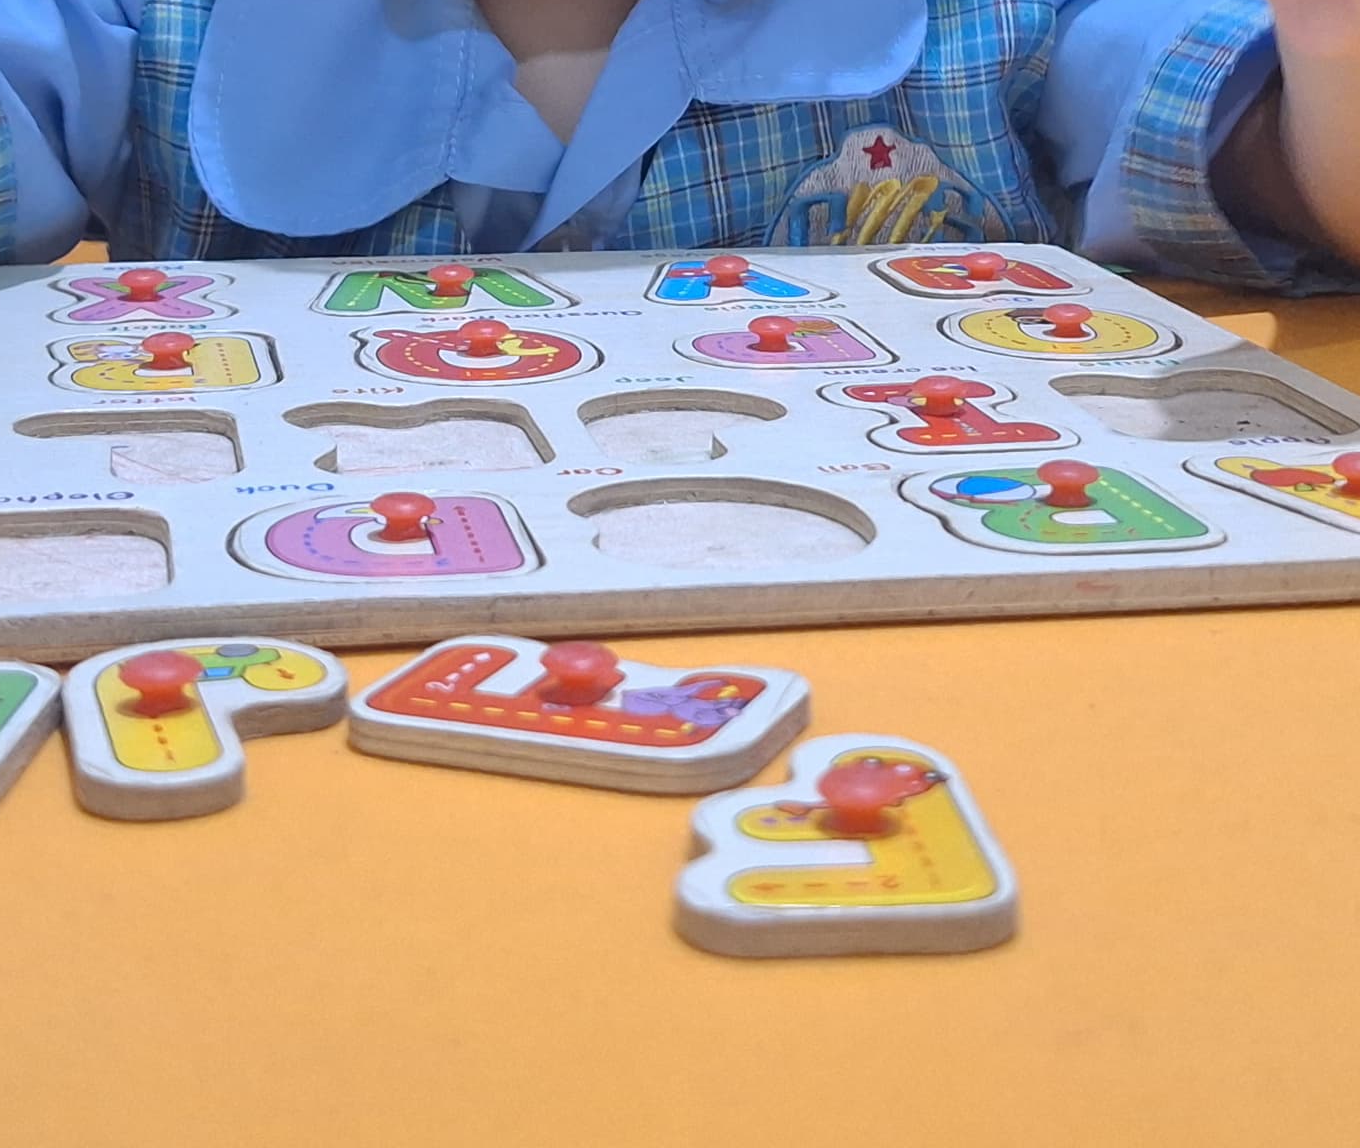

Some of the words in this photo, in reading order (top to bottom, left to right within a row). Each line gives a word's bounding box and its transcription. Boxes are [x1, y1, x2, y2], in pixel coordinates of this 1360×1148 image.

[982, 296, 1035, 305] Owl
[503, 310, 643, 322] Question
[823, 367, 921, 376] cream
[930, 365, 979, 374] Ice
[614, 375, 694, 385] Jeep
[331, 387, 405, 396] Kite
[1227, 435, 1331, 447] Apple
[557, 467, 624, 477] Car
[816, 462, 892, 474] Ball
[234, 483, 336, 495] Duck
